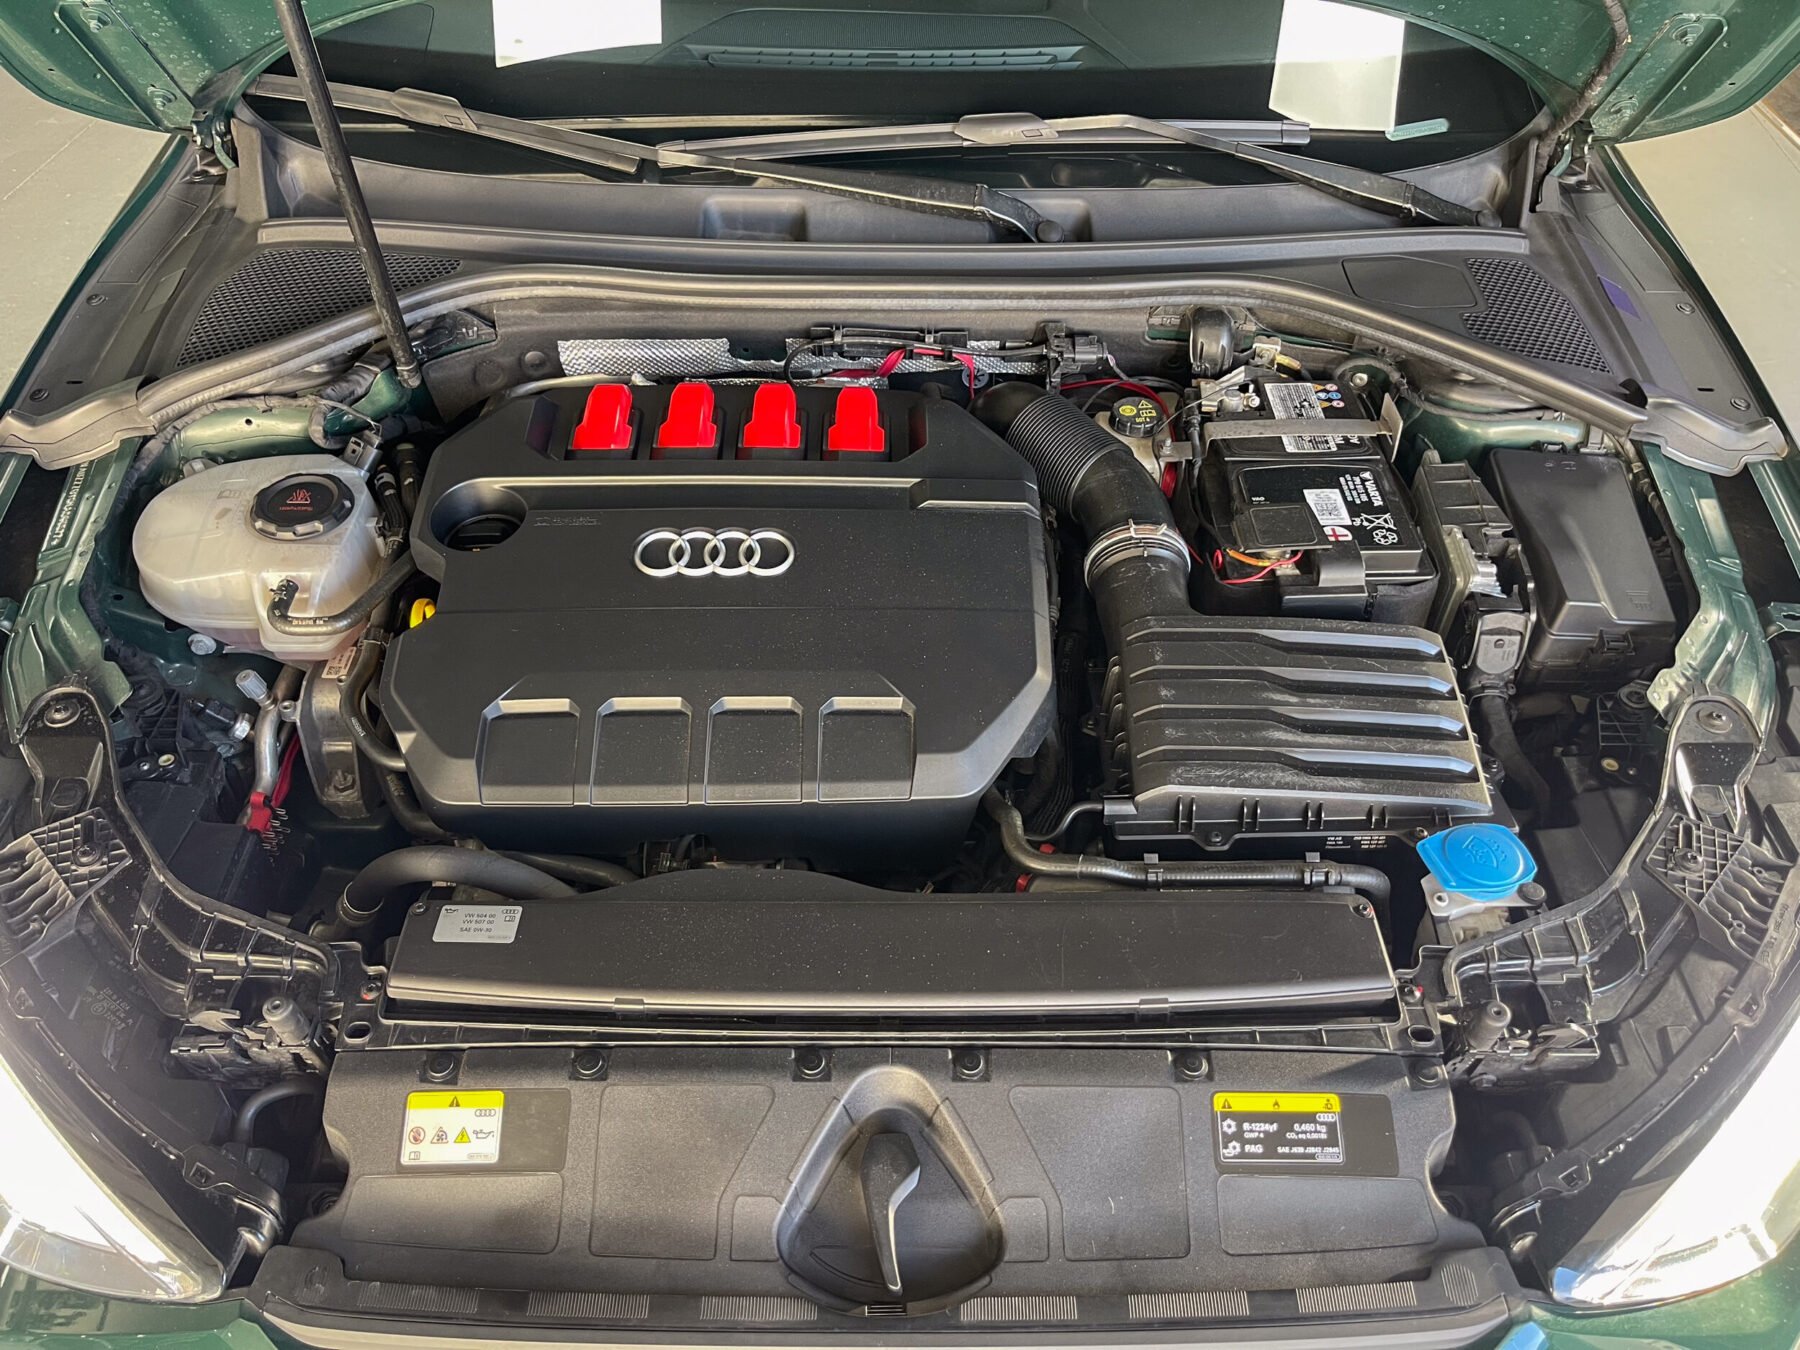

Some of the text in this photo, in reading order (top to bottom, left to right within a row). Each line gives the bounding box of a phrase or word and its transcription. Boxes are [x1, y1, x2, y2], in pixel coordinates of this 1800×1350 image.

[1364, 480, 1384, 507] VARTA
[1351, 517, 1362, 526] Pb
[1243, 1122, 1278, 1133] R-1234yf
[1316, 1123, 1327, 1133] kg
[1244, 1144, 1264, 1153] PAG
